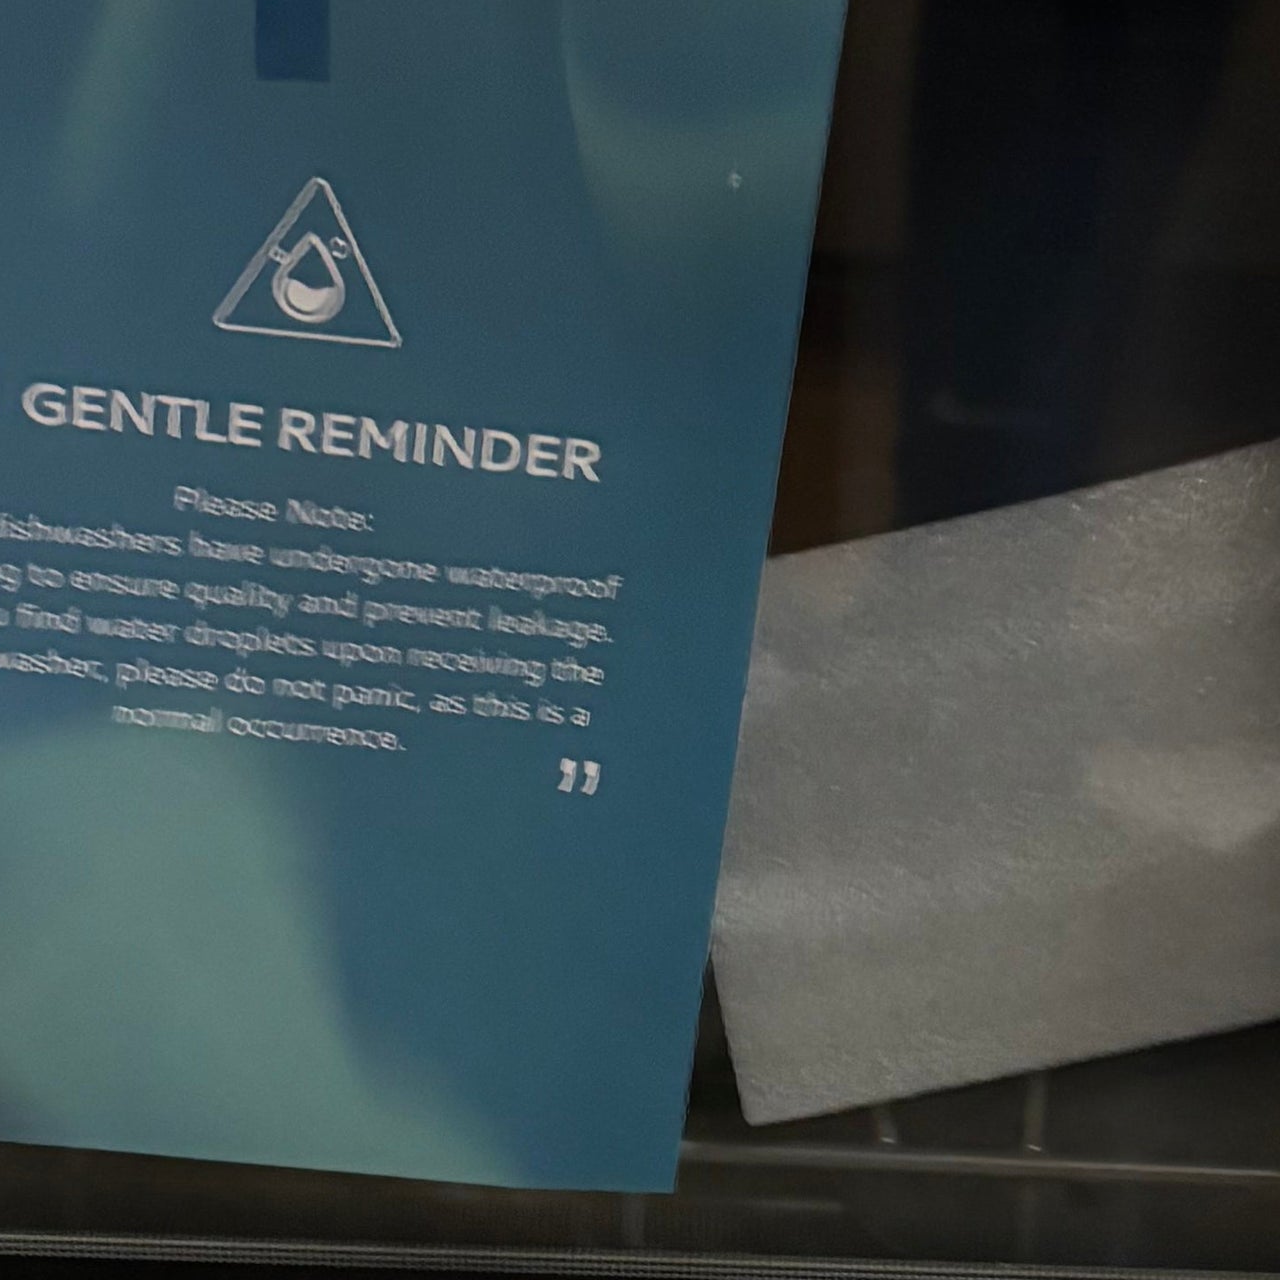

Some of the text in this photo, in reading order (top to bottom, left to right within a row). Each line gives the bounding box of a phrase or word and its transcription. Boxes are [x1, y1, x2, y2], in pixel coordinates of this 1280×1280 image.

[21, 382, 265, 449] GENTLE
[277, 407, 601, 483] REMINDER
[174, 484, 374, 532] Please Note:
[27, 563, 66, 589] to
[70, 570, 181, 601] ensure
[184, 580, 294, 619] quality
[297, 589, 360, 618] and
[363, 600, 483, 631] prevent
[188, 530, 266, 566] have
[269, 544, 440, 585] undergone
[444, 565, 624, 601] waterproof
[16, 603, 82, 635] find
[86, 616, 183, 644] water
[184, 620, 318, 659] droplets
[321, 640, 404, 669] upon
[405, 647, 547, 688] receiving
[549, 656, 605, 686] the
[112, 704, 225, 734] normal
[115, 657, 220, 691] please
[224, 666, 266, 696] do
[272, 677, 328, 702] not
[428, 692, 468, 716] as
[471, 691, 532, 722] this
[535, 699, 566, 726] is
[569, 706, 592, 728] a
